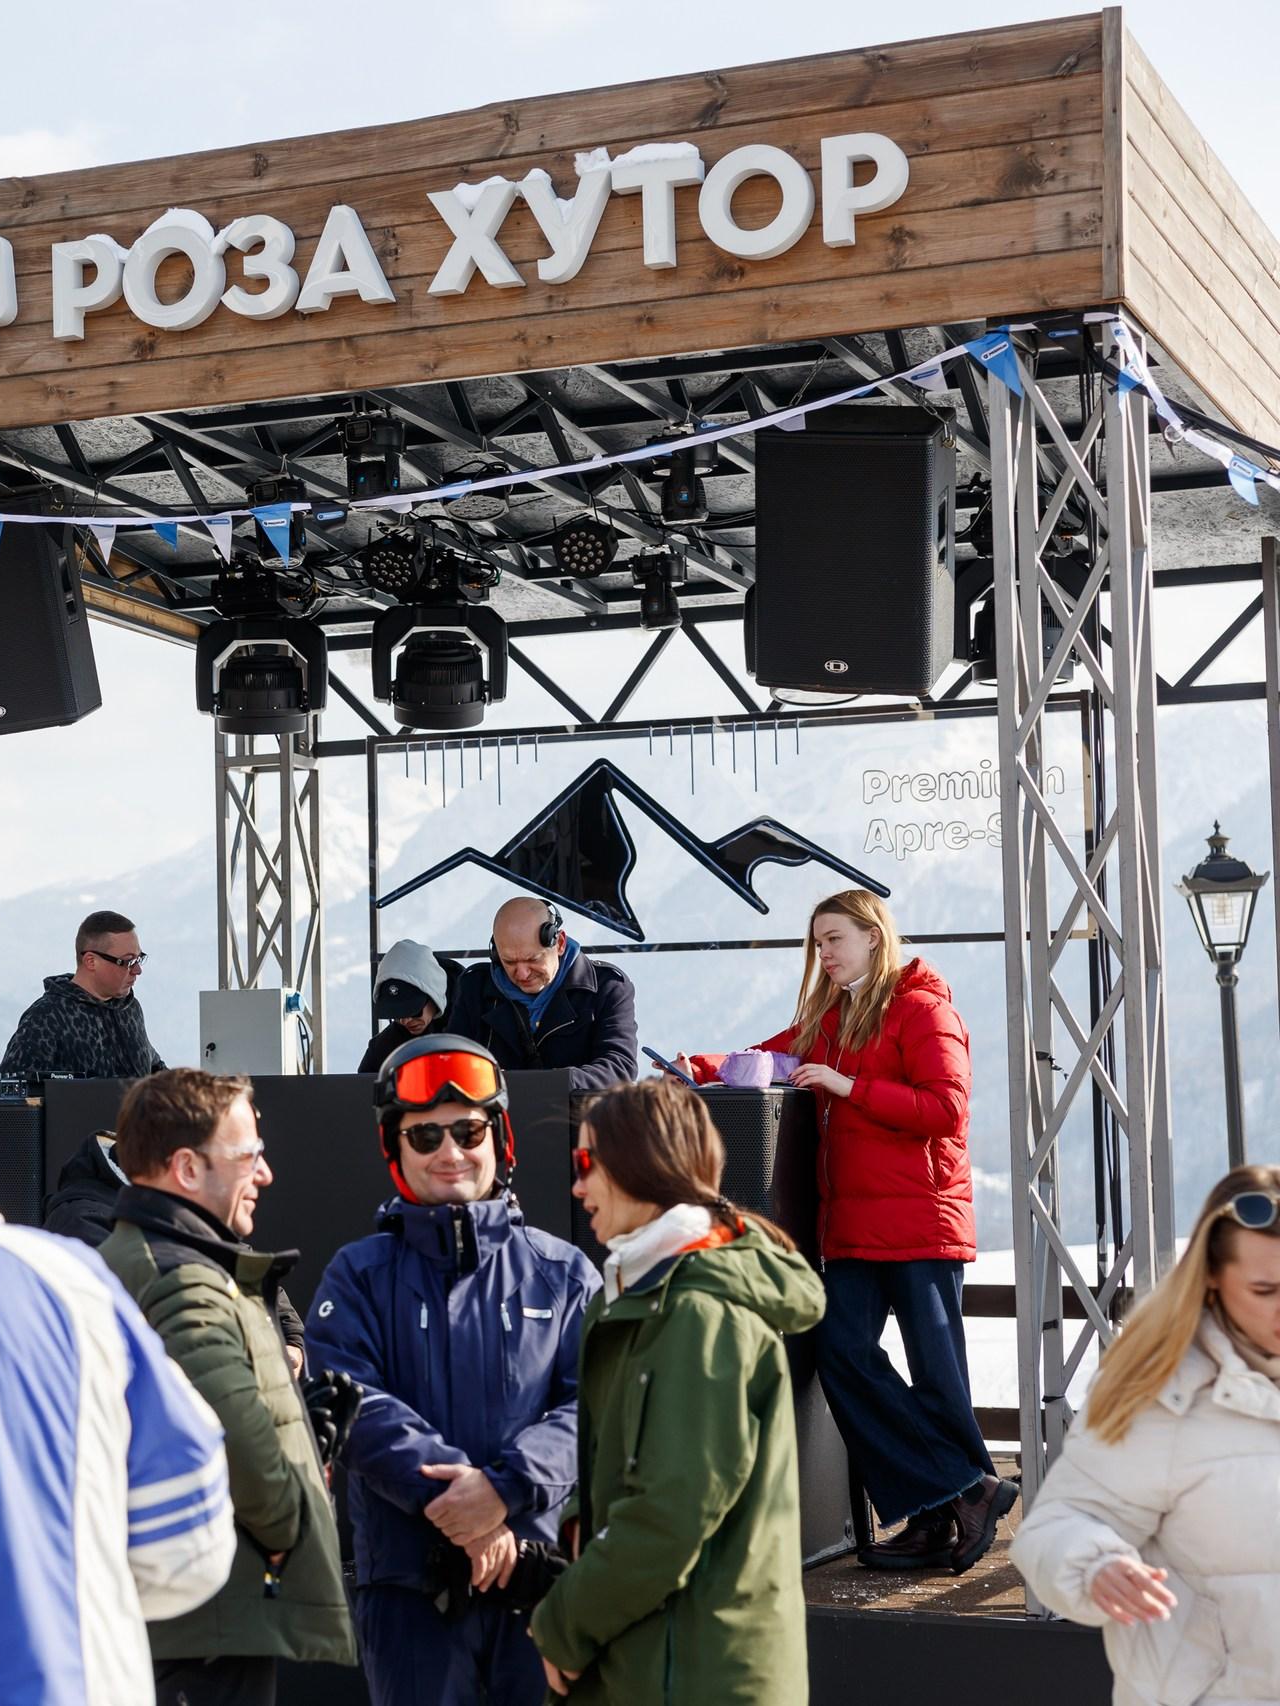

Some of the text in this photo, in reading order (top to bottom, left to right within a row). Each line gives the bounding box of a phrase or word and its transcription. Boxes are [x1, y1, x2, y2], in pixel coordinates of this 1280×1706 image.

[51, 132, 910, 341] РОЗА ХУТОР
[862, 759, 1065, 804] Premi
